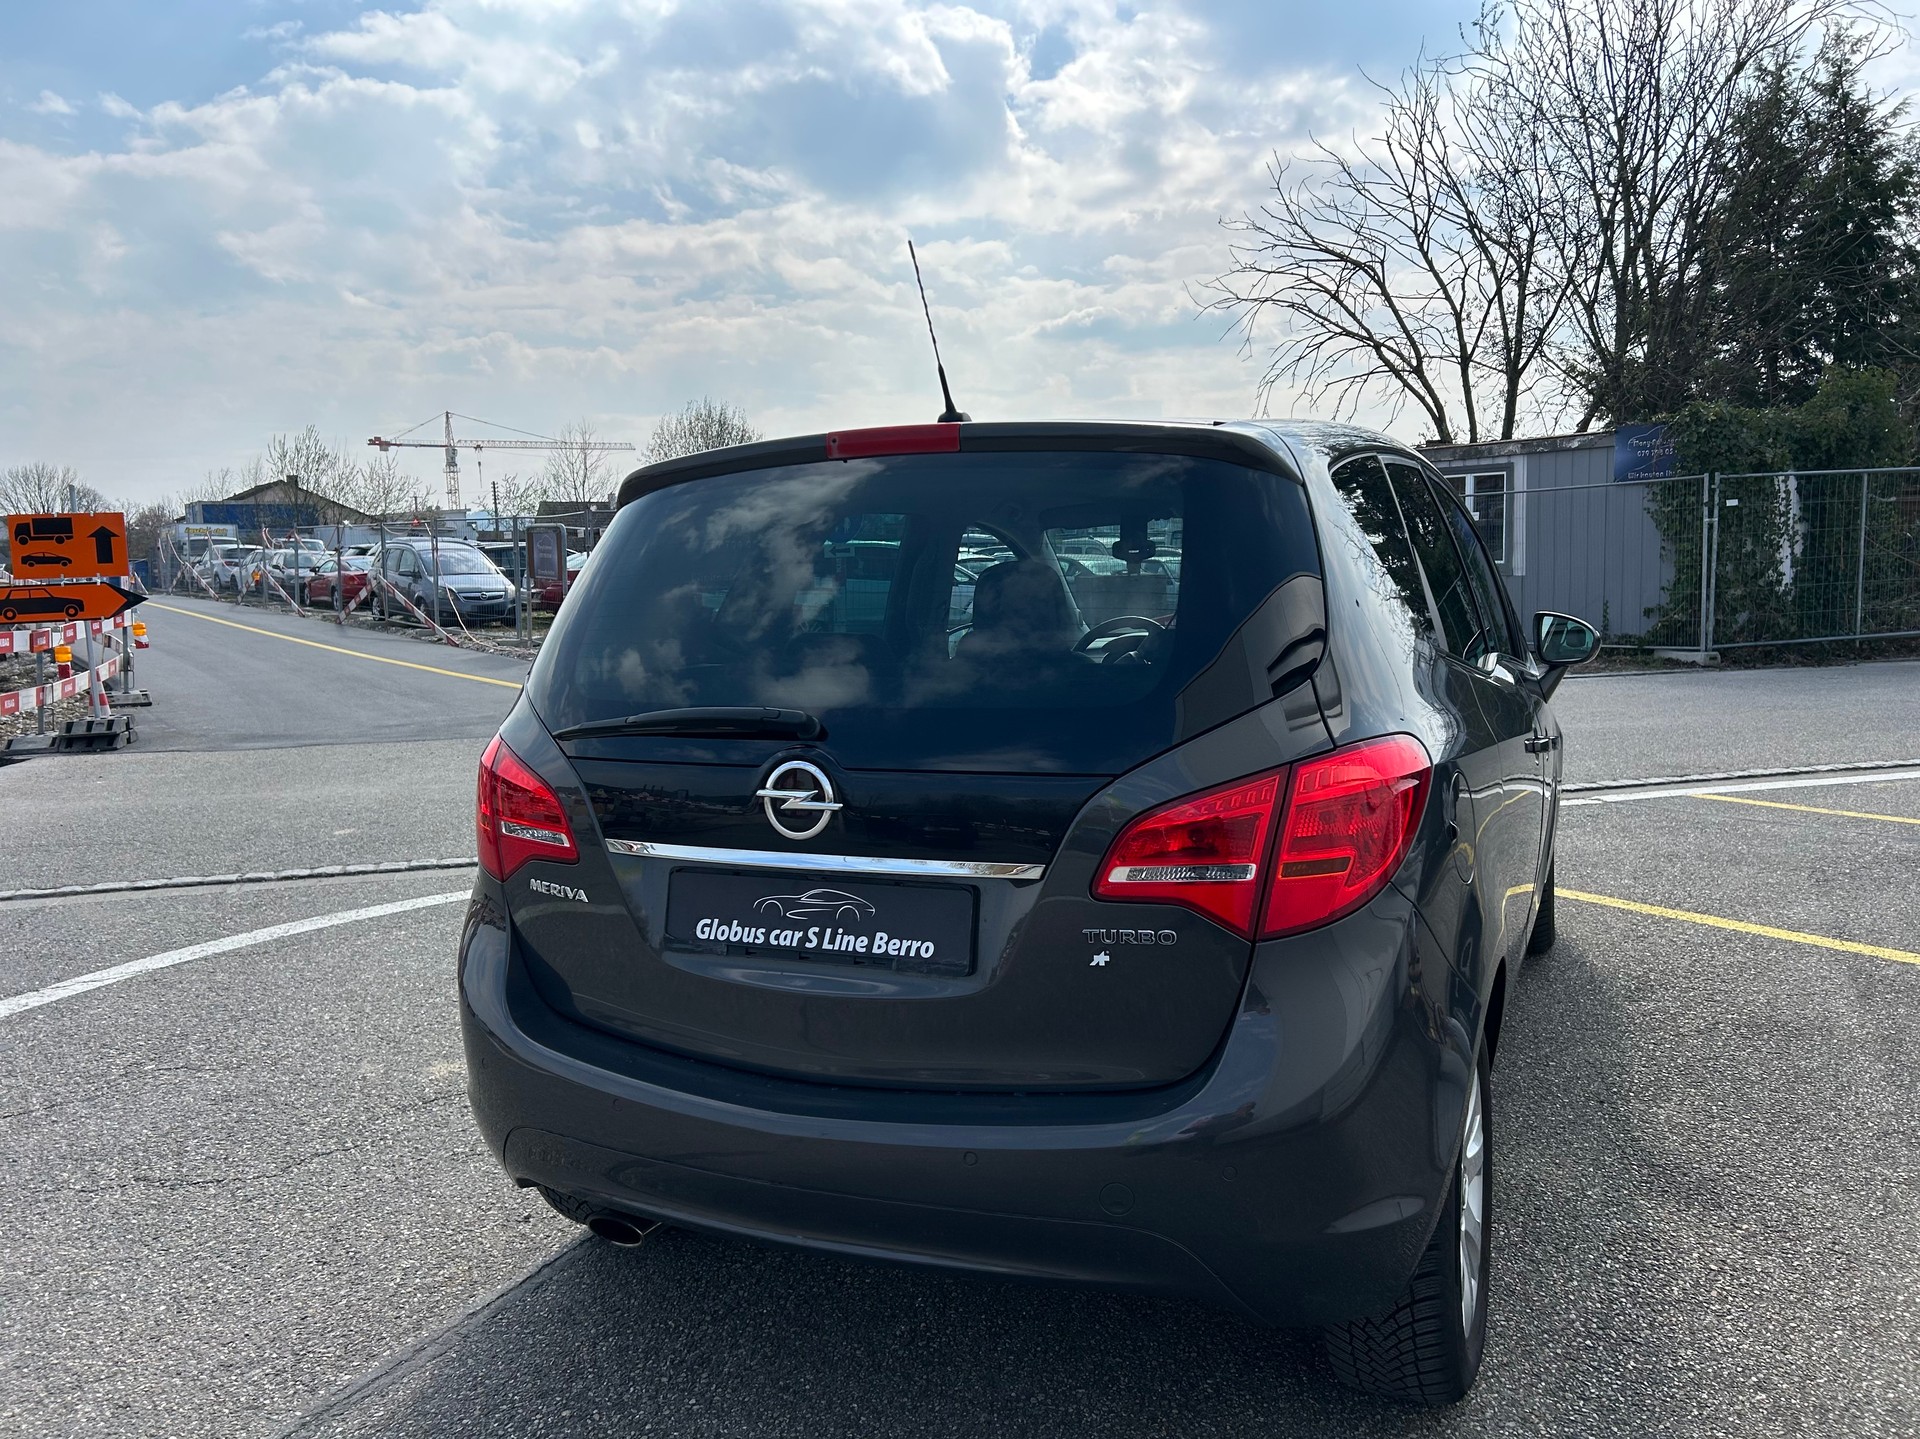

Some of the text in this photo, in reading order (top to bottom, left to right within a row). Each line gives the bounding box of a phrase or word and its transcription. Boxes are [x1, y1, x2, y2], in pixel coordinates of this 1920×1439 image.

[530, 878, 589, 903] MERIVA
[695, 918, 935, 959] Globus car S Line Berro
[1082, 929, 1177, 945] TURBO
